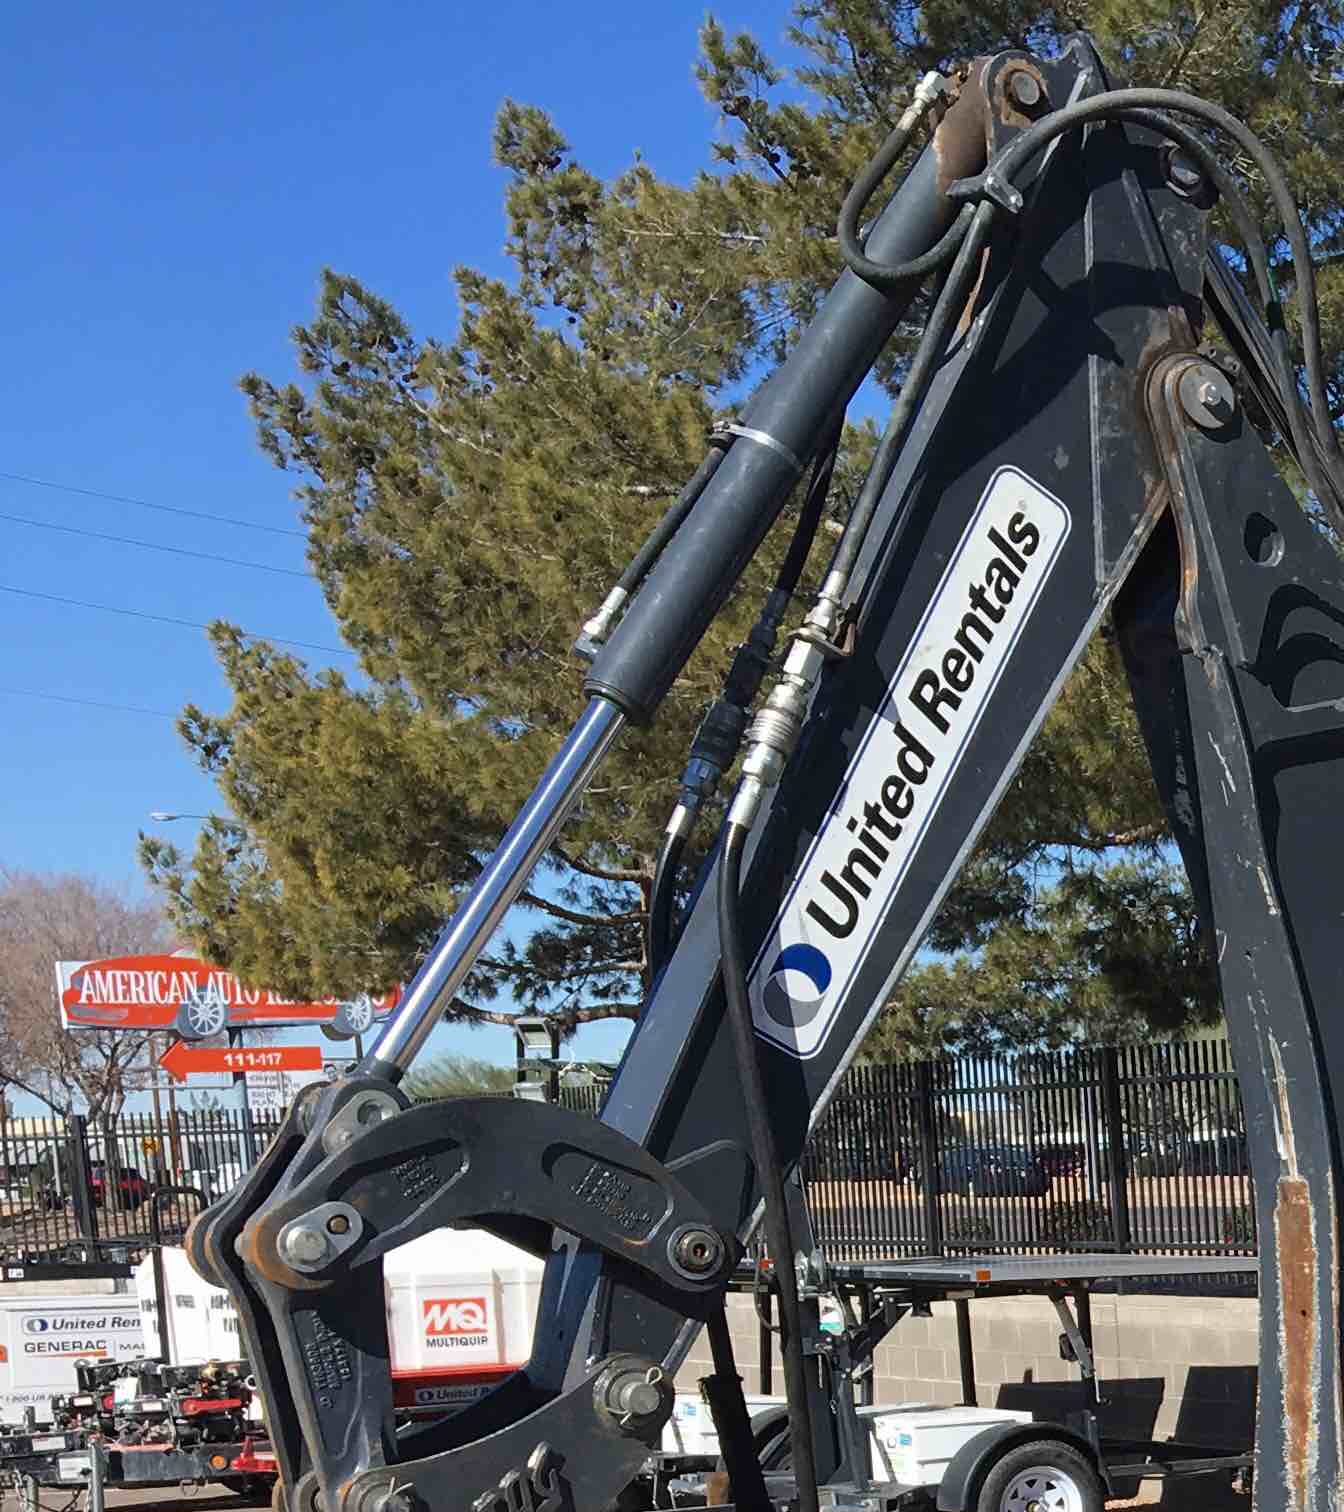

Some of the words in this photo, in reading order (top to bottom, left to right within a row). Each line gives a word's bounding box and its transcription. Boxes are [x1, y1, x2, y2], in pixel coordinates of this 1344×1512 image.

[805, 720, 936, 939] United
[908, 511, 1041, 736] Rentals
[79, 970, 198, 1005] AMERICAN
[224, 1053, 282, 1067] 111-117
[52, 1317, 106, 1330] United
[424, 1301, 487, 1332] MQ
[24, 1340, 107, 1354] GENERAC
[426, 1336, 488, 1348] MULTIQUIP
